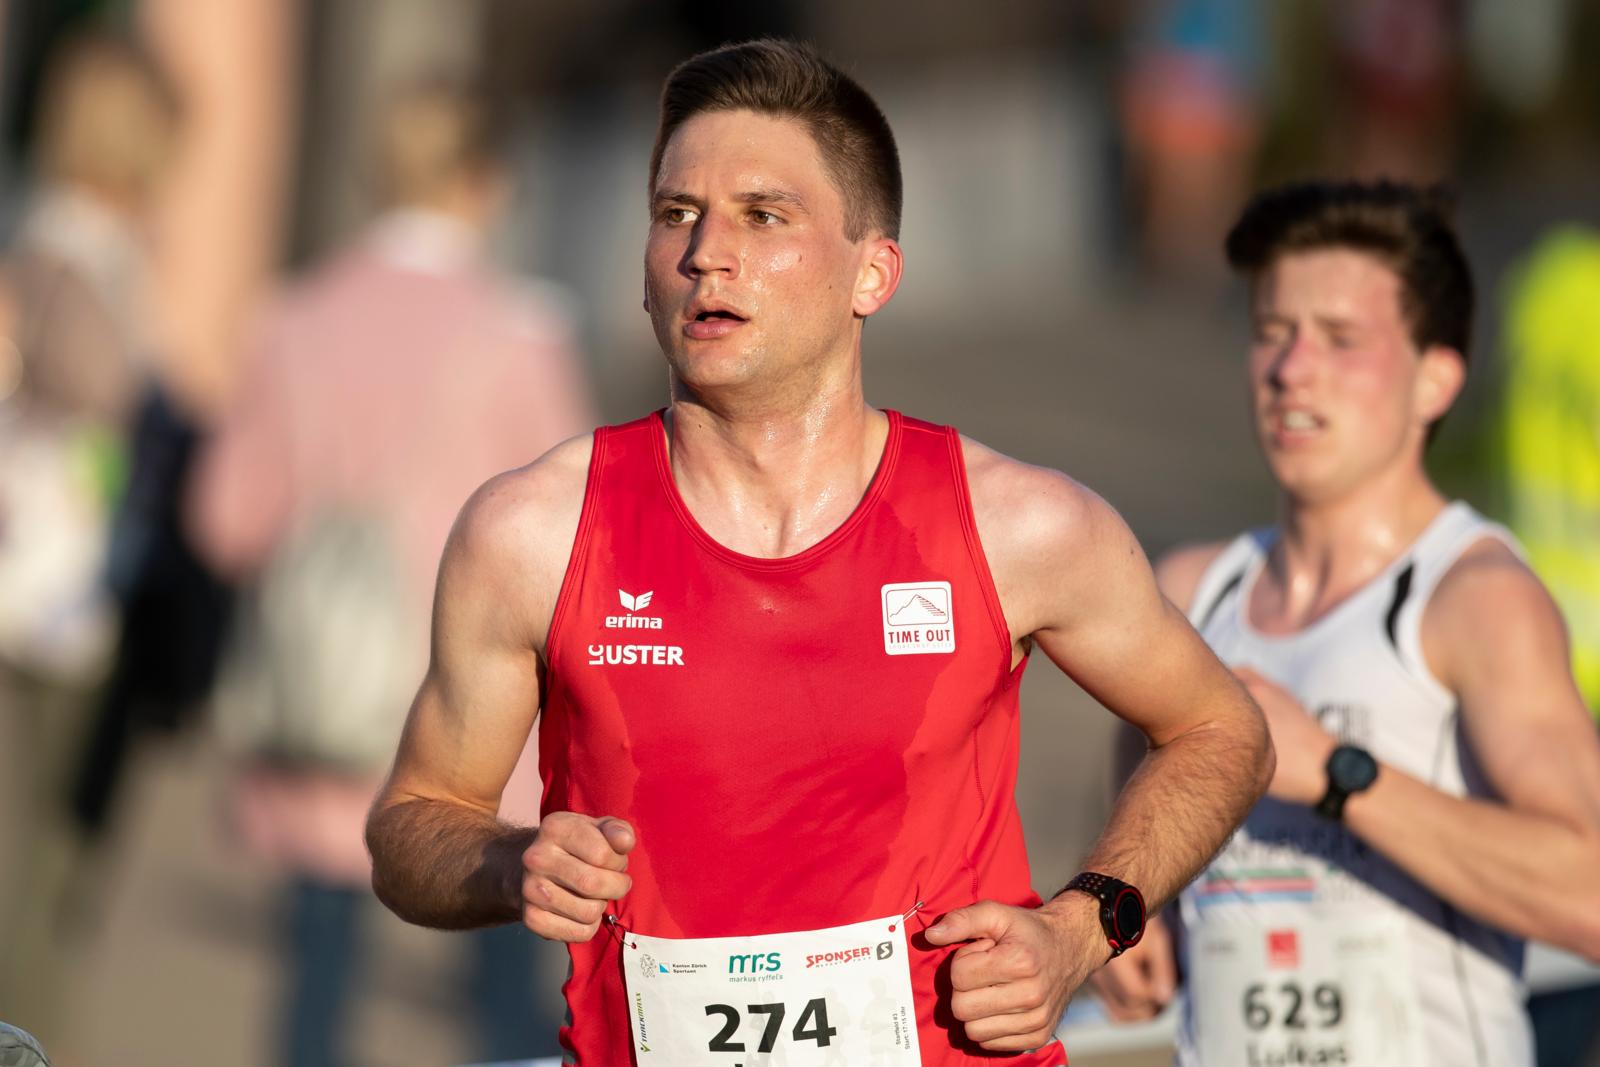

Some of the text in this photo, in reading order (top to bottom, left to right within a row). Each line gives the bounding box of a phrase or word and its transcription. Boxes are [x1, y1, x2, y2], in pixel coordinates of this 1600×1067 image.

[605, 613, 663, 630] erima
[888, 629, 951, 644] TIME OUT
[588, 645, 685, 666] LC USTER
[805, 946, 871, 968] SPONSER
[729, 975, 756, 983] markus
[1243, 981, 1344, 1030] 629
[704, 997, 837, 1054] 274
